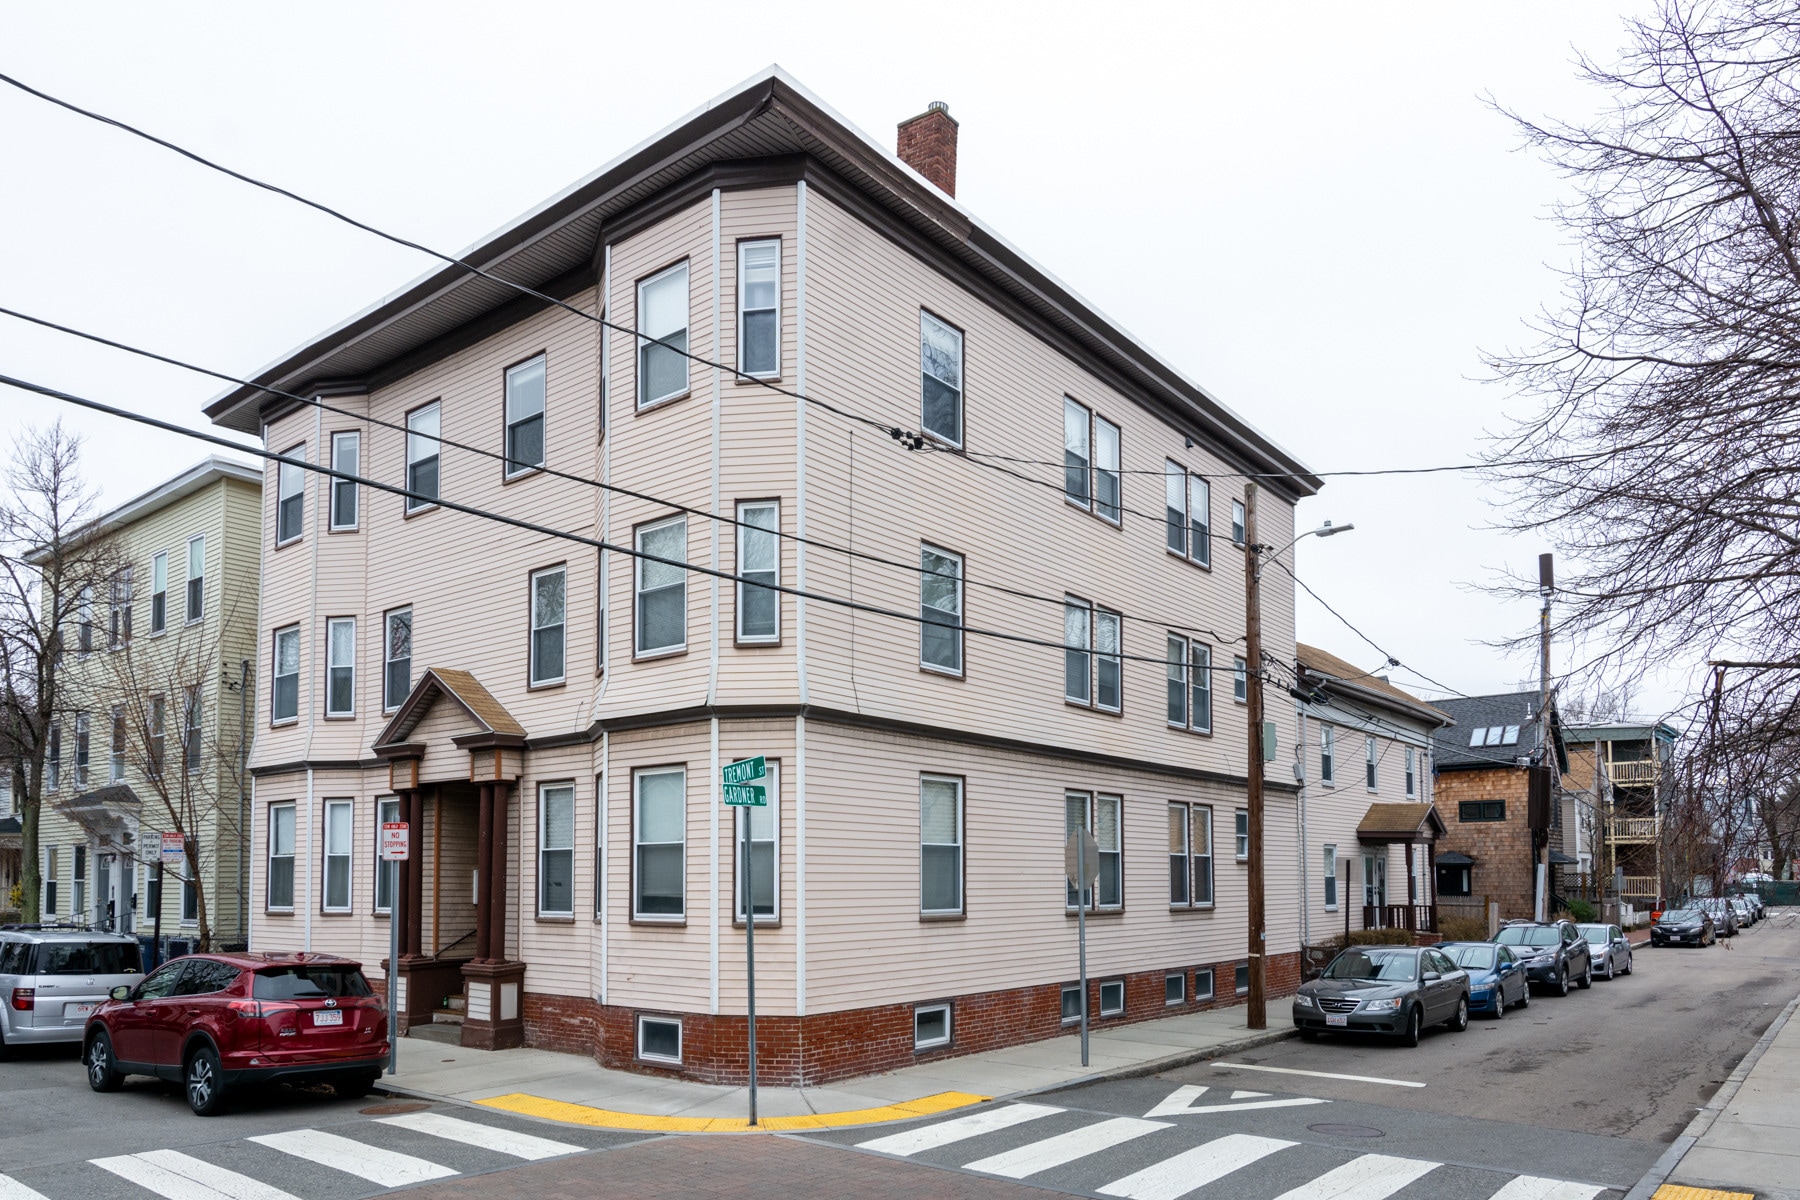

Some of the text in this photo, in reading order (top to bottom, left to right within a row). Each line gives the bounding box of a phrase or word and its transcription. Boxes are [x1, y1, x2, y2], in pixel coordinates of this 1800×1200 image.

[724, 761, 765, 783] TREMONT ST
[724, 786, 755, 804] GARDNER
